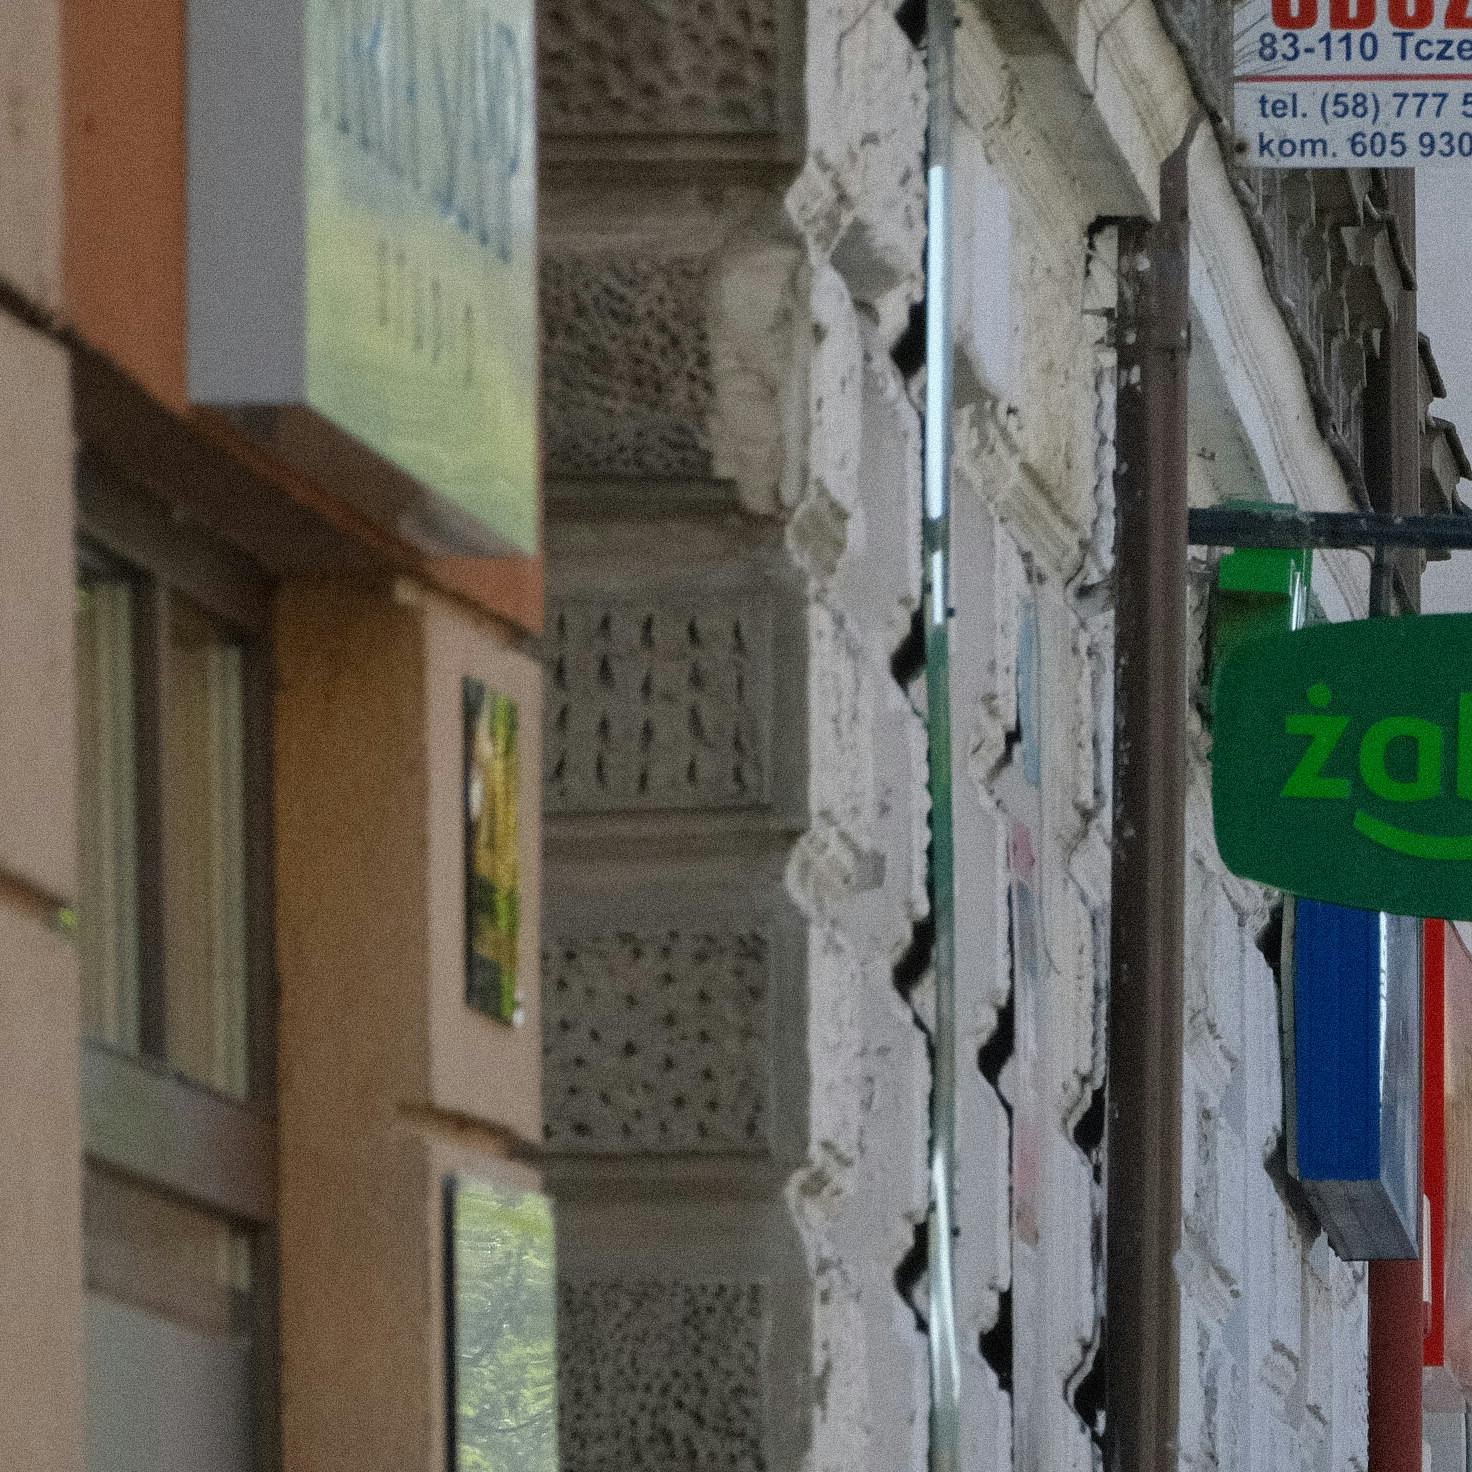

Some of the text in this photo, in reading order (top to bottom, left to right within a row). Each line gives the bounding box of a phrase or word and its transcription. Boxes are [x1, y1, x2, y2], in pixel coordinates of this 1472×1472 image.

[1258, 32, 1381, 63] 83-110
[1258, 92, 1307, 120] tel.
[1319, 91, 1382, 123] (58)
[1393, 91, 1452, 120] 777
[1257, 128, 1337, 158] kom.
[1349, 130, 1408, 160] 605
